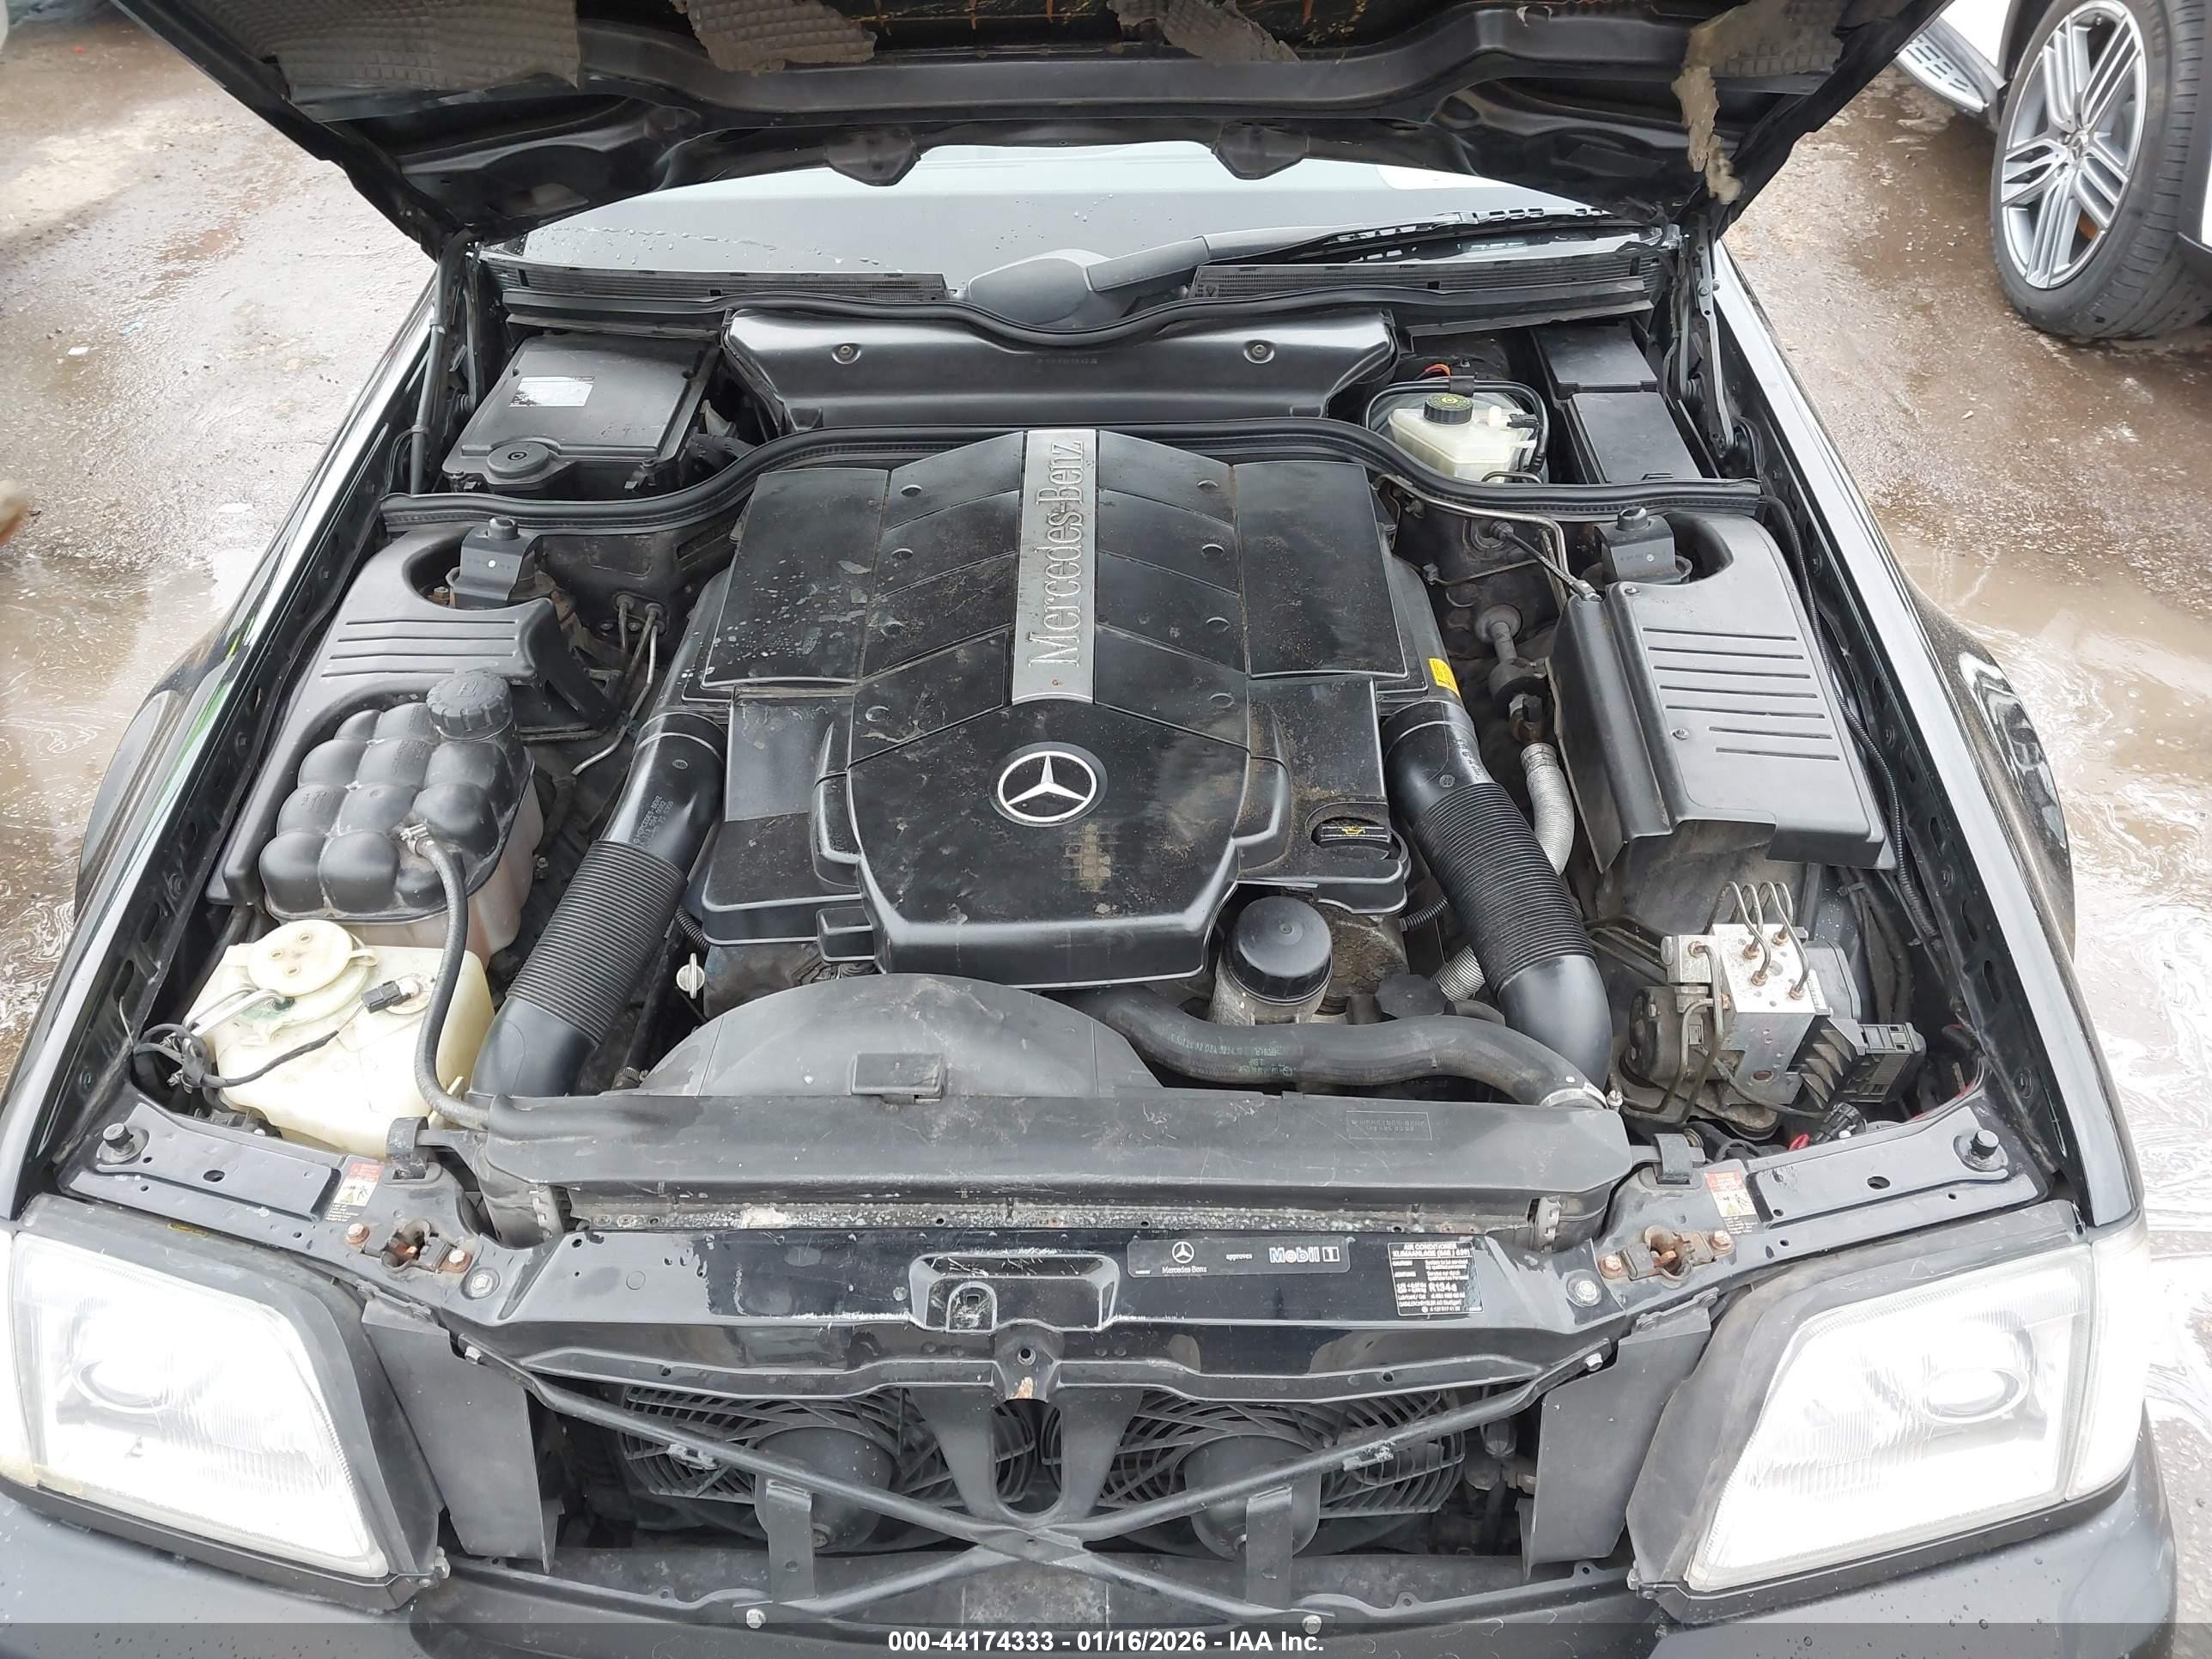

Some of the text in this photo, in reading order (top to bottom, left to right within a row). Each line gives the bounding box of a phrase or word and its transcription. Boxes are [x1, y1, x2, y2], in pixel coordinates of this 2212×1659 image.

[1028, 440, 1085, 667] Mercedes-Benz
[1225, 1253, 1253, 1261] approves
[1269, 1246, 1321, 1263] Mobil
[1428, 1282, 1457, 1292] R134a
